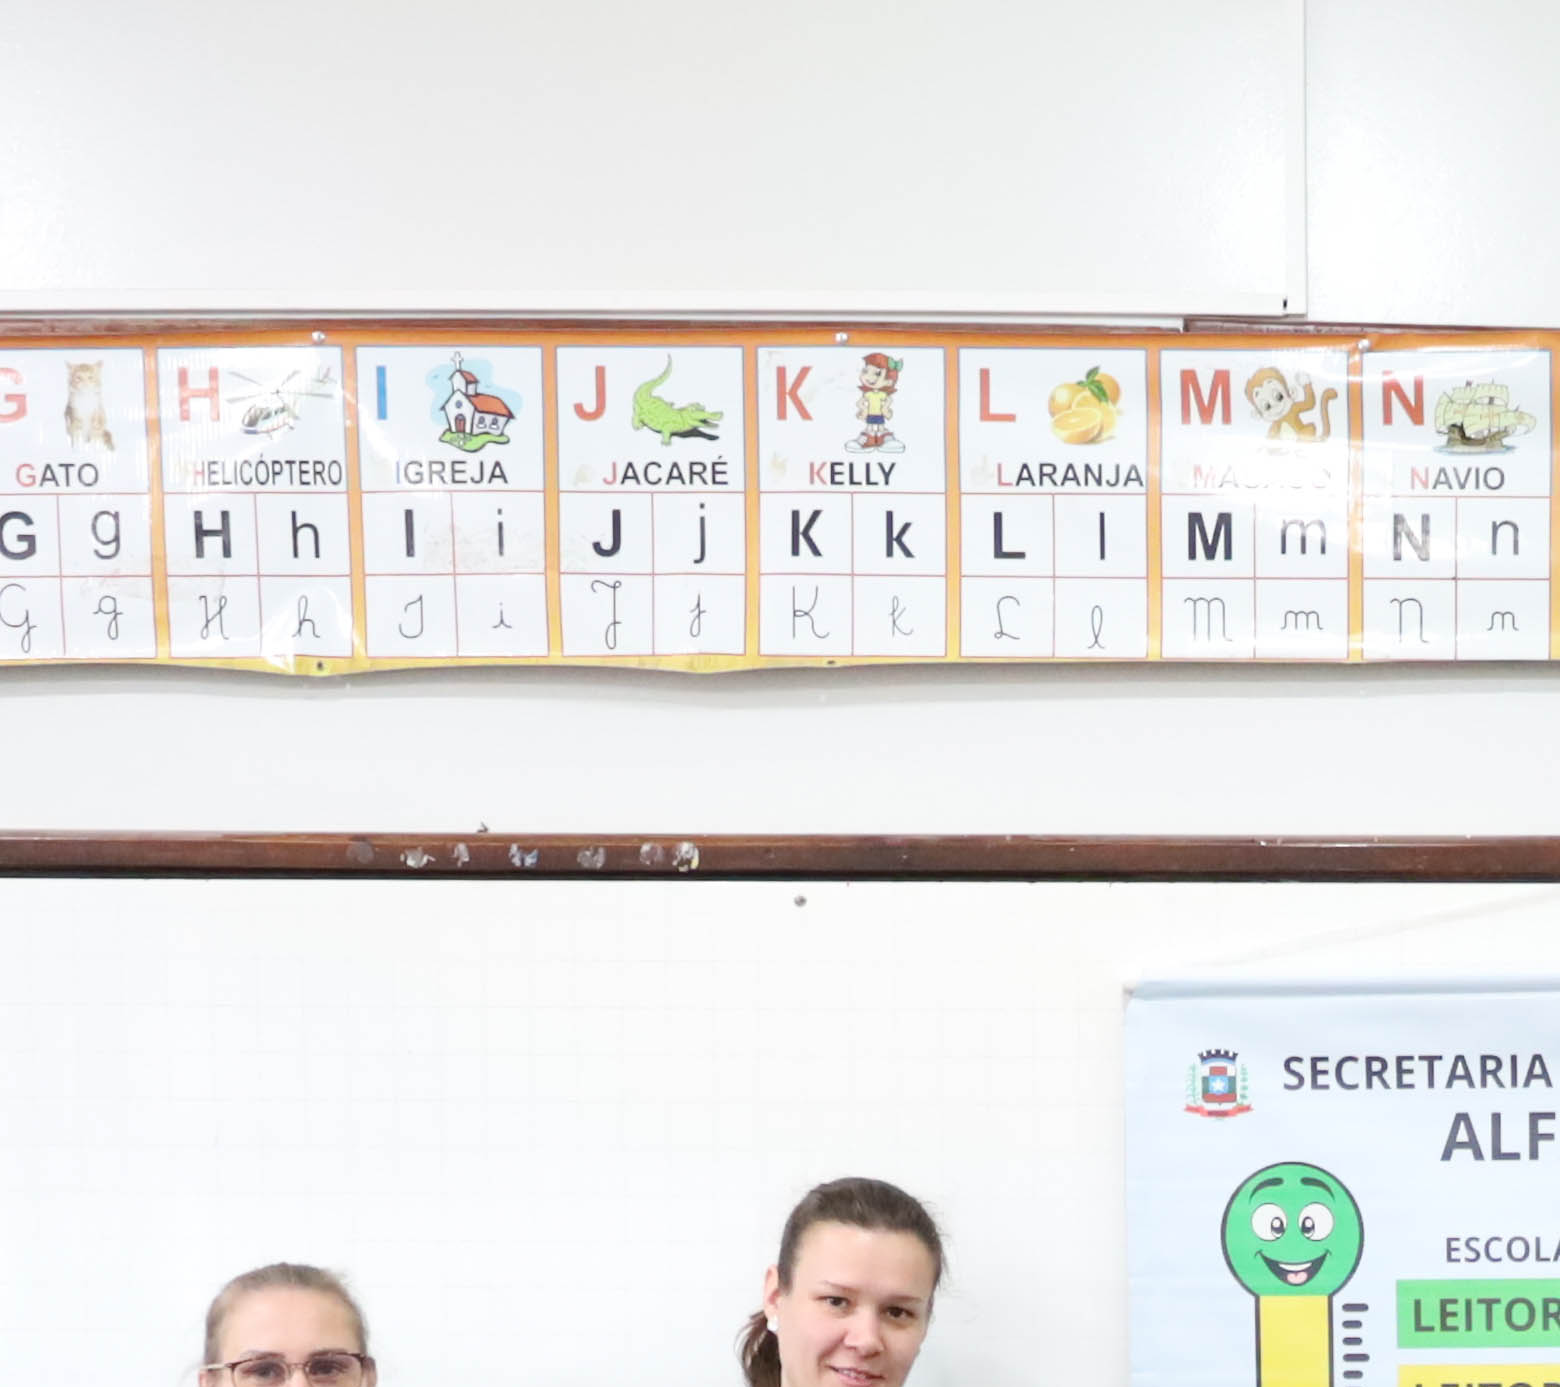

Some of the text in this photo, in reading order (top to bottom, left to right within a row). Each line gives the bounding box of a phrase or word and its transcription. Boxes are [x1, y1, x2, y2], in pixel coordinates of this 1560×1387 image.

[14, 463, 100, 489] GATO
[189, 455, 344, 488] HELICÓPTERO
[393, 460, 508, 486] IGREJA
[601, 455, 729, 487] JACARÉ
[808, 461, 896, 487] KELLY
[995, 463, 1146, 491] LARANJA
[1409, 464, 1505, 491] NAVIO
[1283, 1051, 1553, 1089] SECRETARIA
